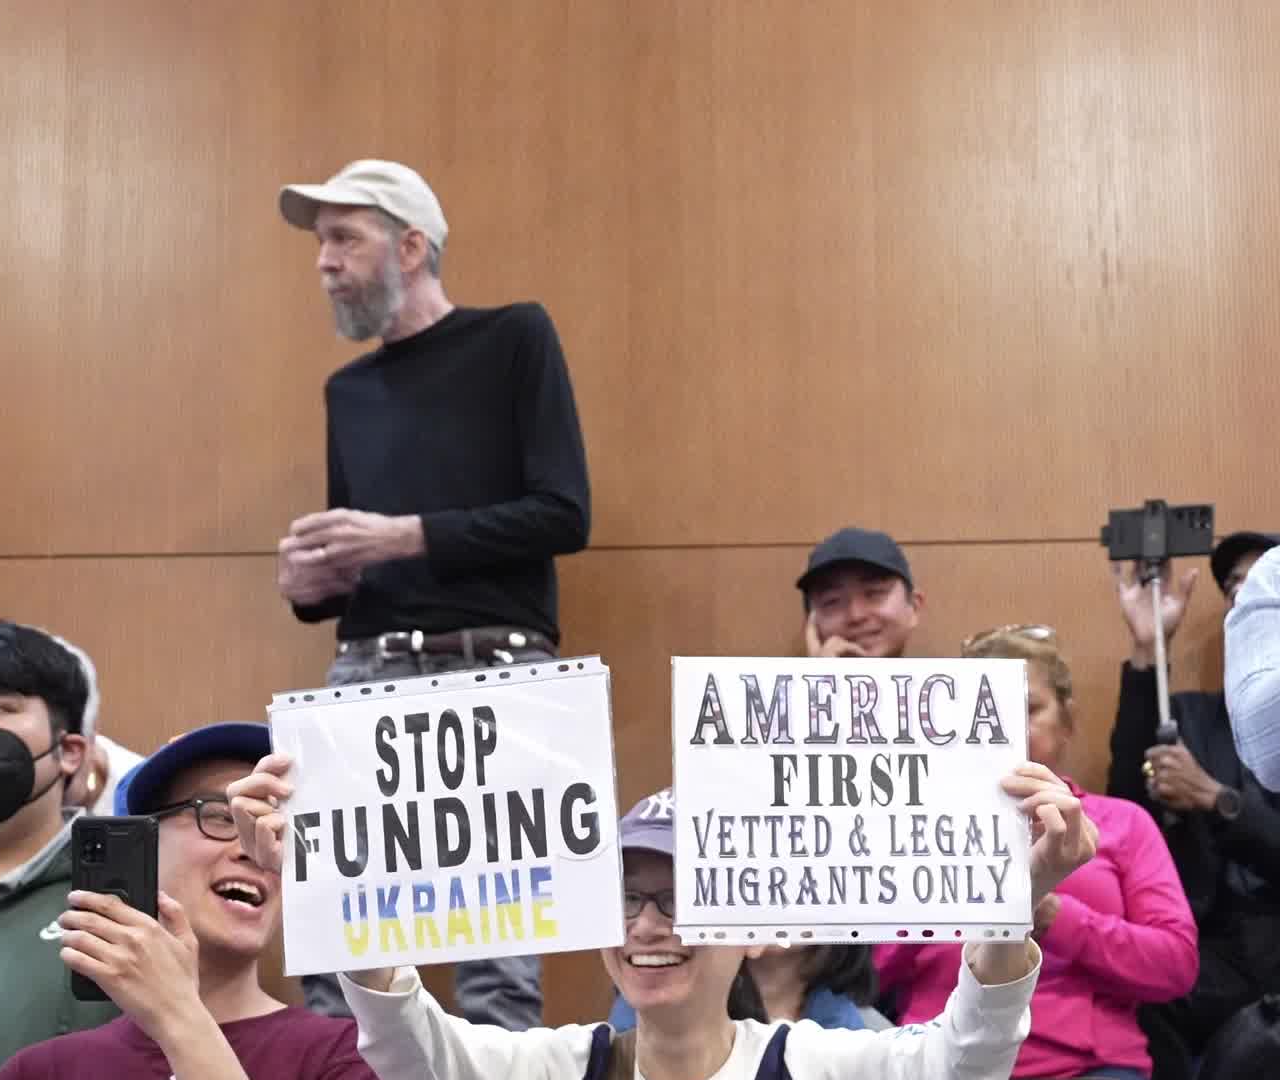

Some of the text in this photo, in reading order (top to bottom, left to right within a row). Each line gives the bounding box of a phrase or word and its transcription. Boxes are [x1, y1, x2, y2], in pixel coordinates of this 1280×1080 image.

[690, 673, 1010, 746] AMERICA
[374, 706, 497, 797] STOP
[769, 752, 929, 808] FIRST
[292, 782, 602, 882] FUNDING
[691, 807, 1011, 859] VETTED & LEGAL
[341, 865, 558, 958] UKRAINE
[693, 856, 1013, 907] MIGRANTS ONLY
